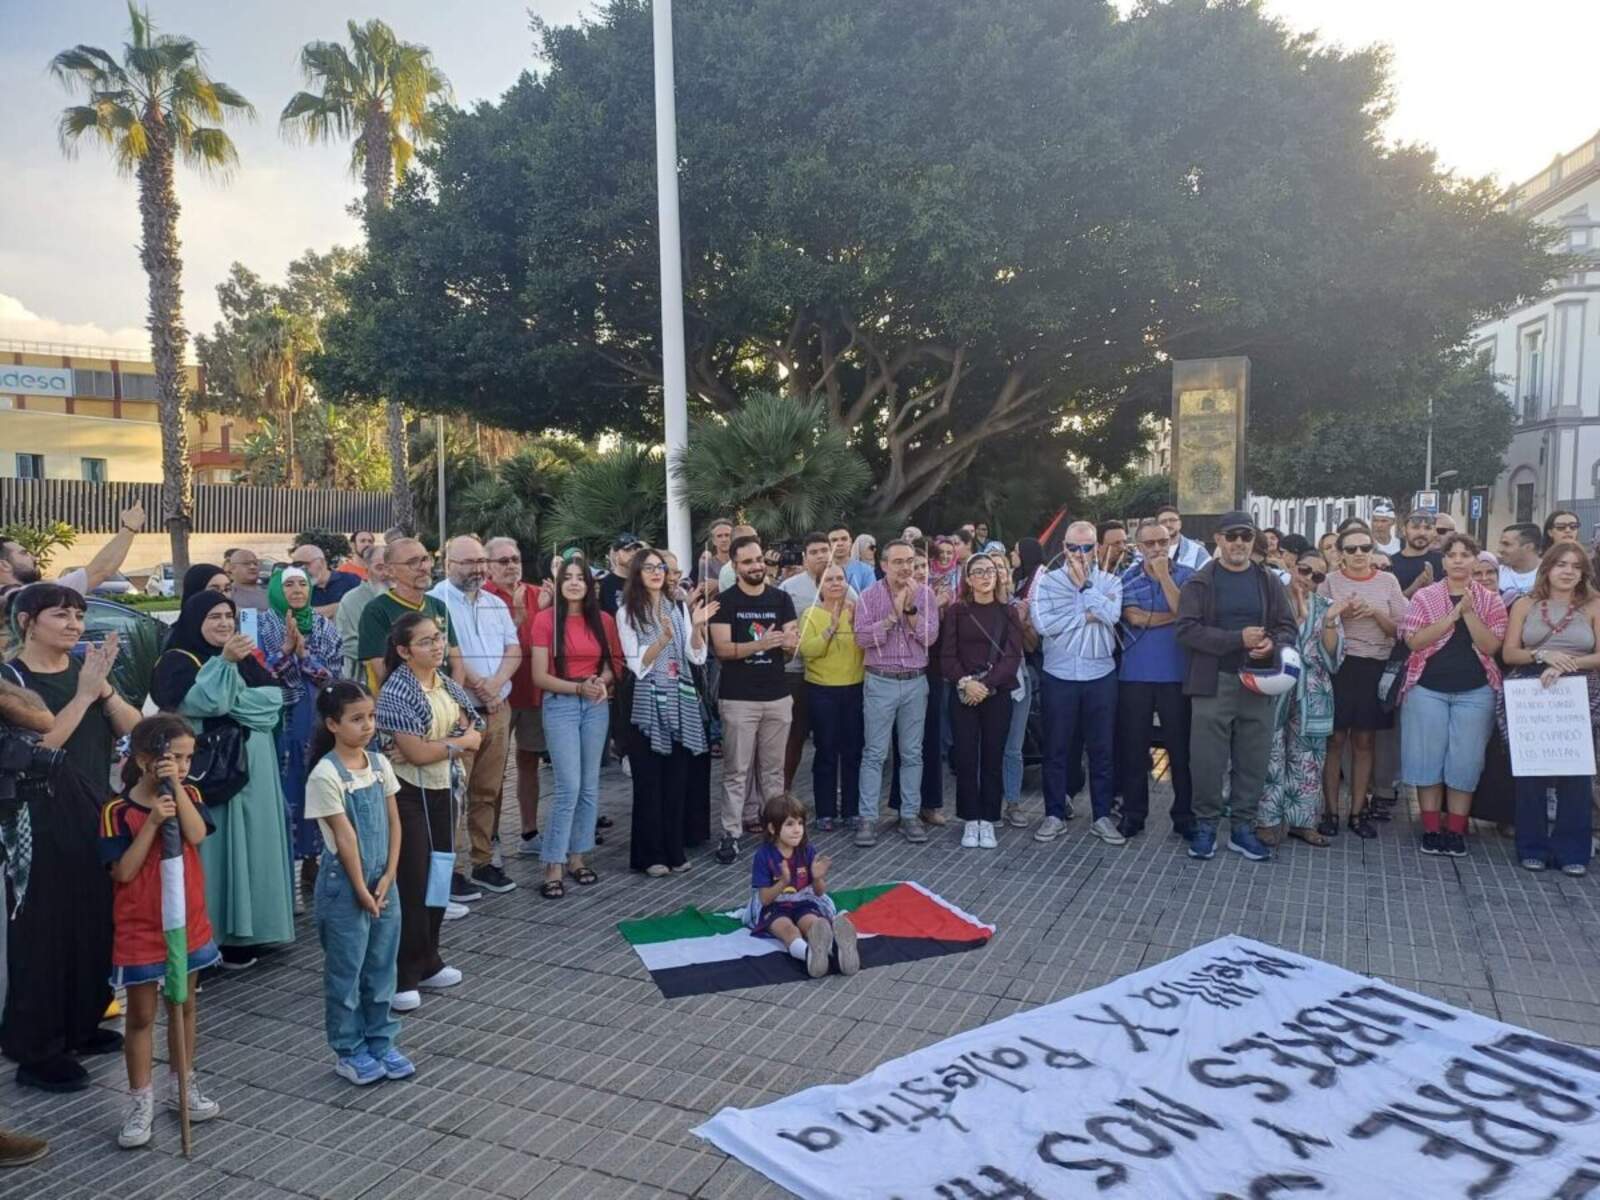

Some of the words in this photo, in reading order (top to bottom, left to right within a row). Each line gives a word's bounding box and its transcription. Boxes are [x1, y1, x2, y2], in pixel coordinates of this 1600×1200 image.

[1472, 499, 1480, 518] P
[1073, 1003, 1179, 1052] X
[1189, 986, 1457, 1103] LIBRES
[776, 1035, 1096, 1152] Palestina
[1036, 1086, 1224, 1190] NOS
